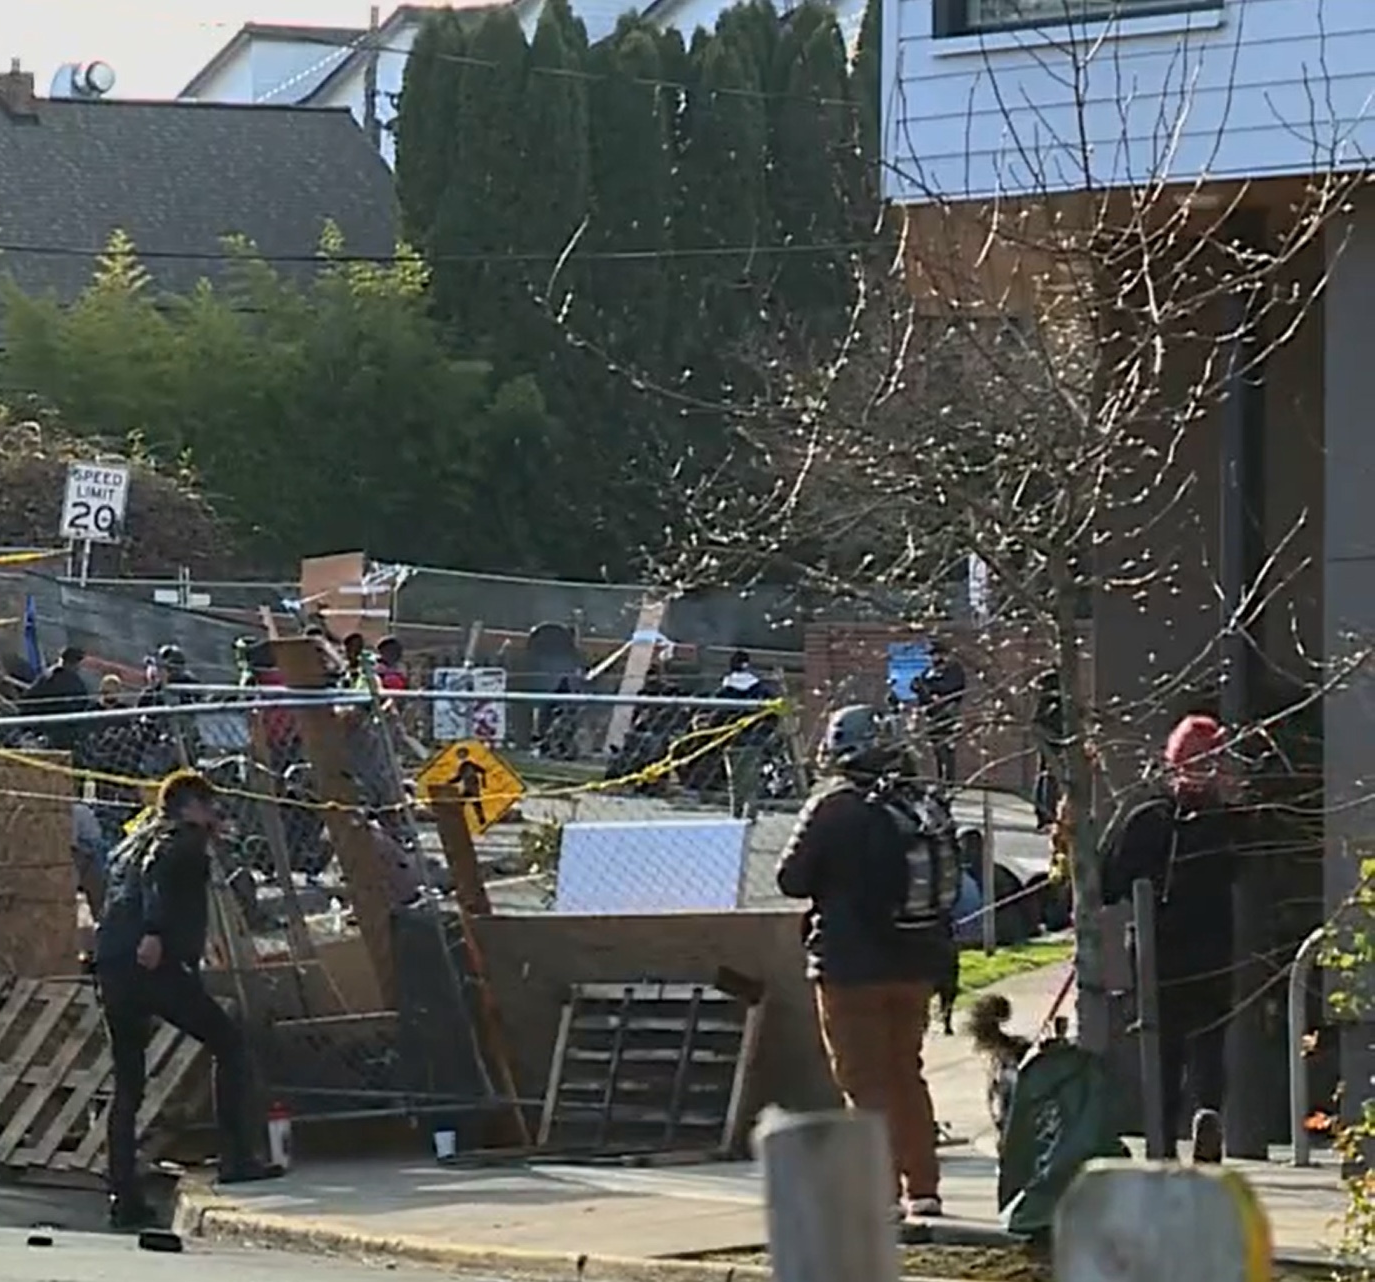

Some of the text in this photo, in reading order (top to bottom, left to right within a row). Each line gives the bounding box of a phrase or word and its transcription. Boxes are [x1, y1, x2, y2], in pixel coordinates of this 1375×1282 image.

[71, 468, 123, 486] SPEED
[76, 484, 114, 500] LIMIT
[68, 502, 115, 532] 20
